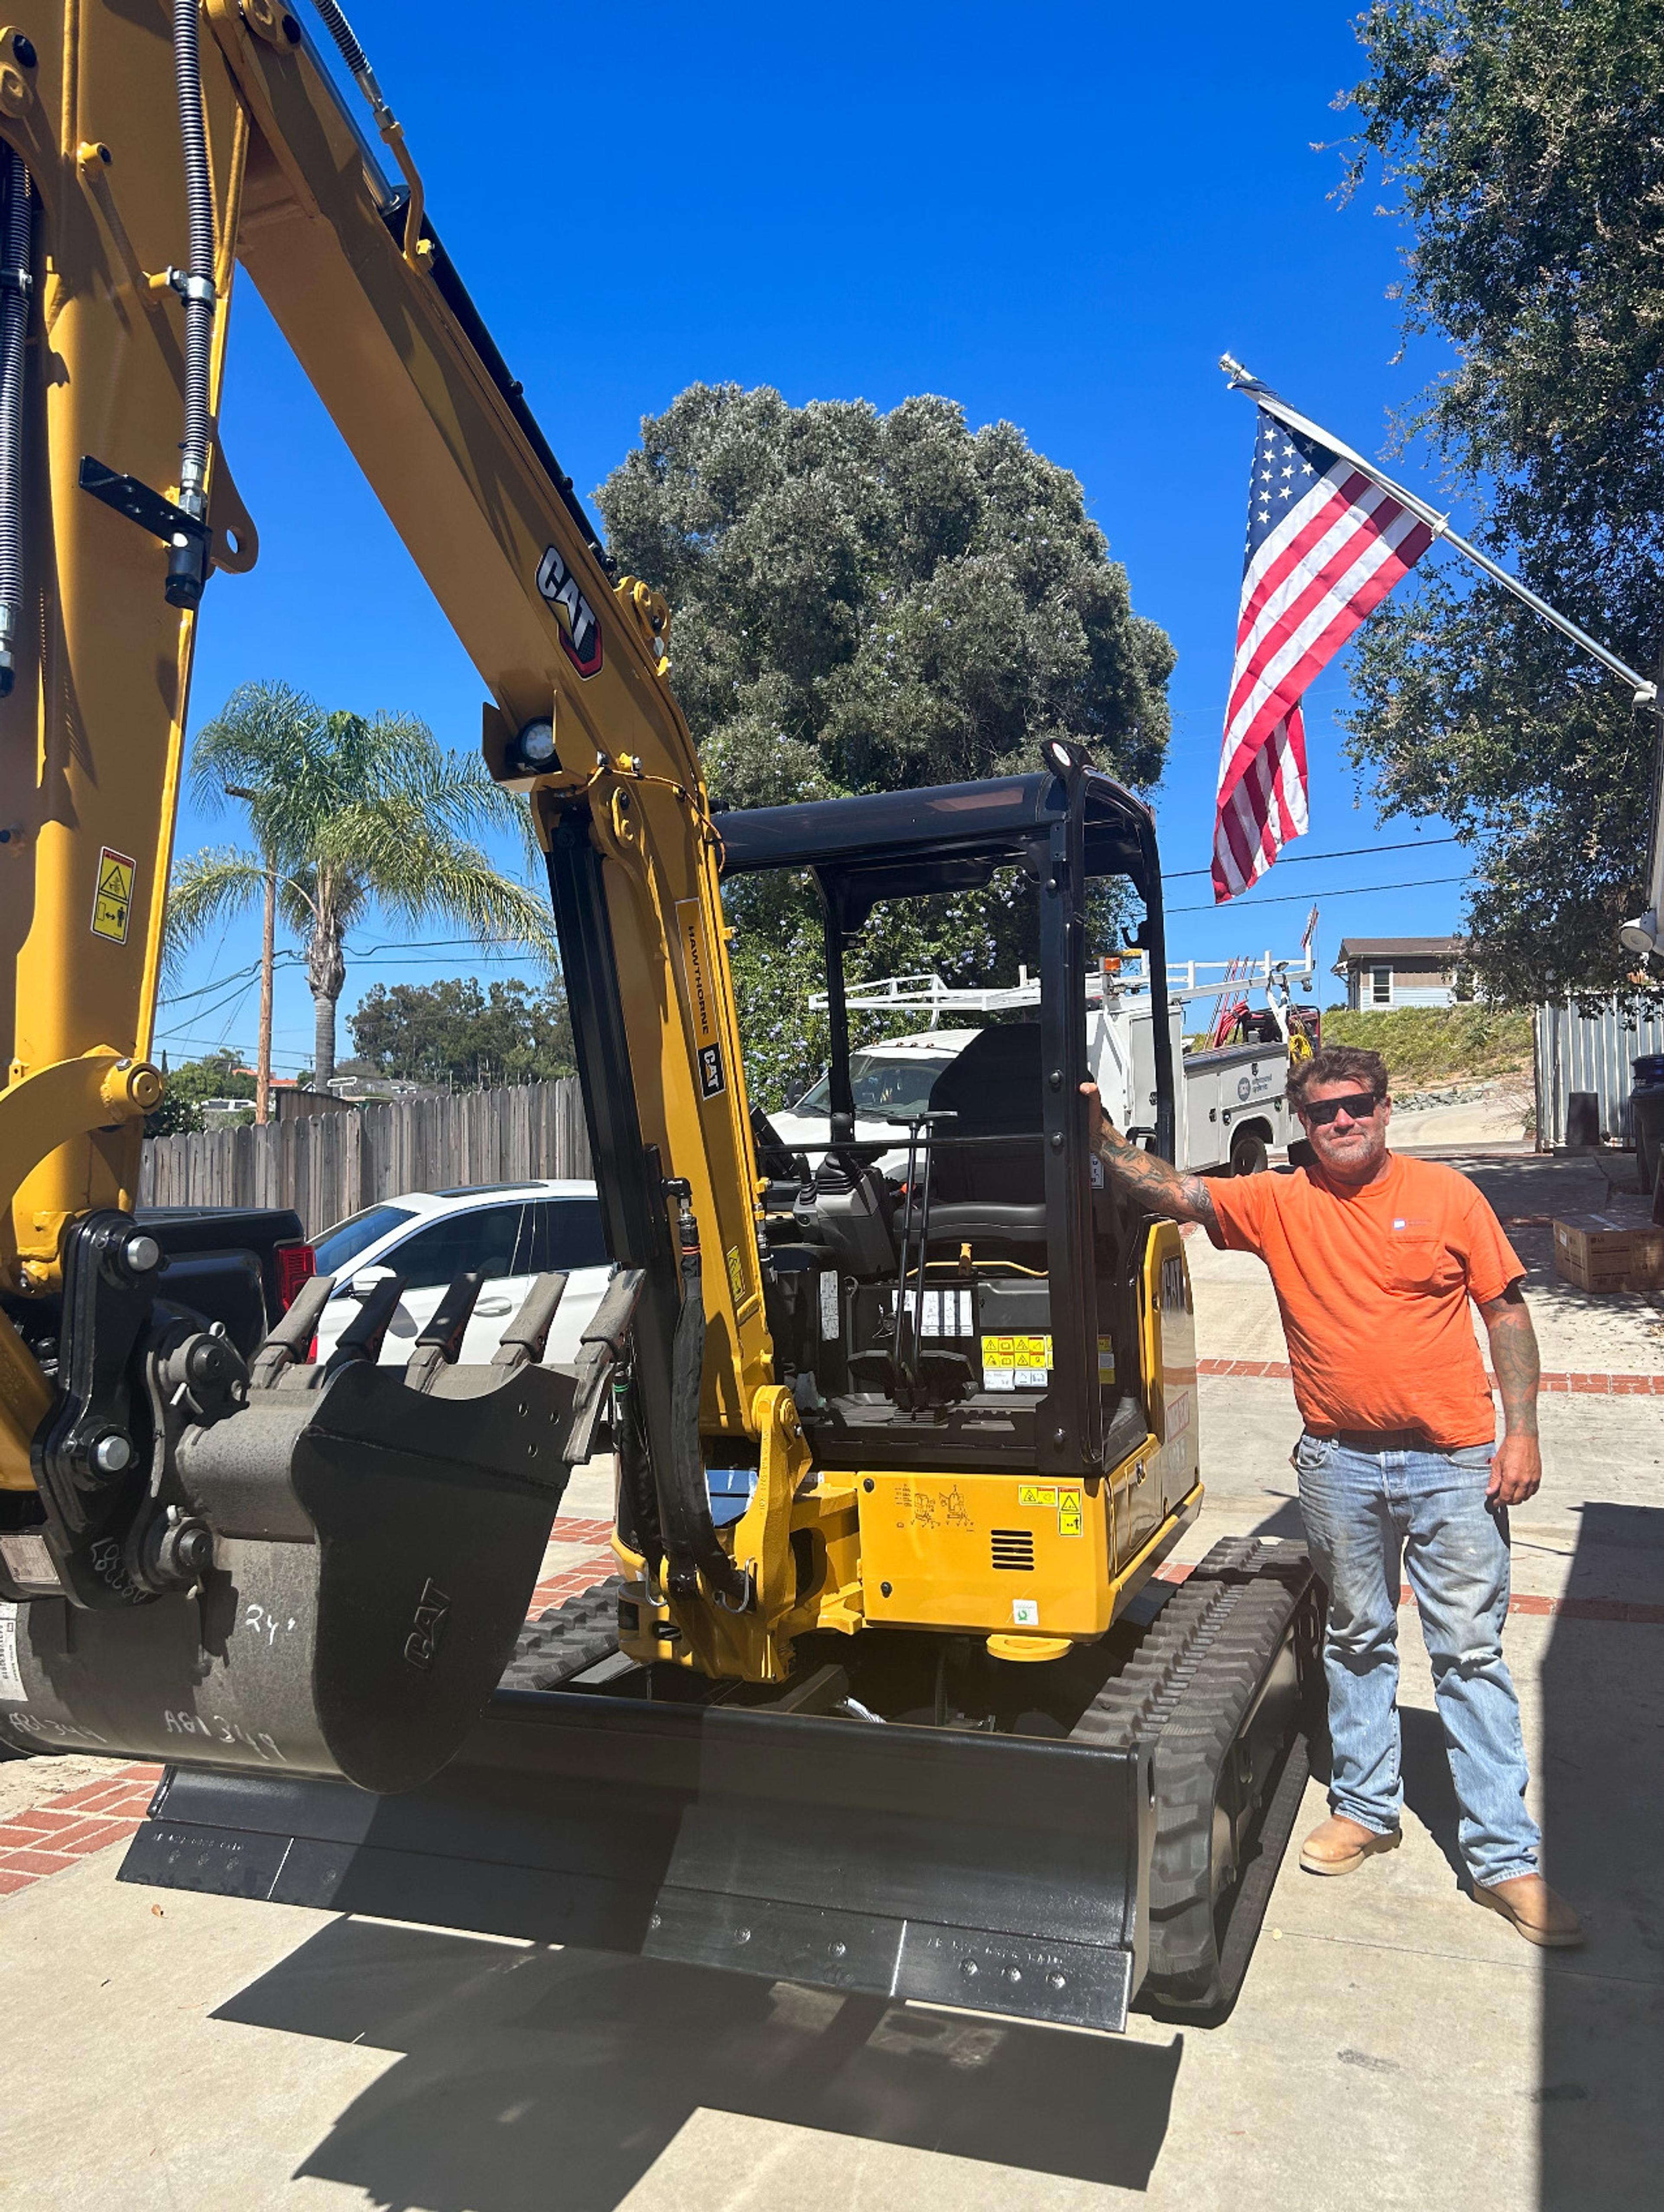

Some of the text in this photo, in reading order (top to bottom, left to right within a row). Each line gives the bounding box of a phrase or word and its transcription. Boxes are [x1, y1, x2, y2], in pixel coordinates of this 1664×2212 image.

[537, 547, 596, 650] CAT
[688, 926, 709, 1034] HAWTHORNE
[703, 1049, 720, 1090] CAT
[403, 1577, 452, 1670] CAT
